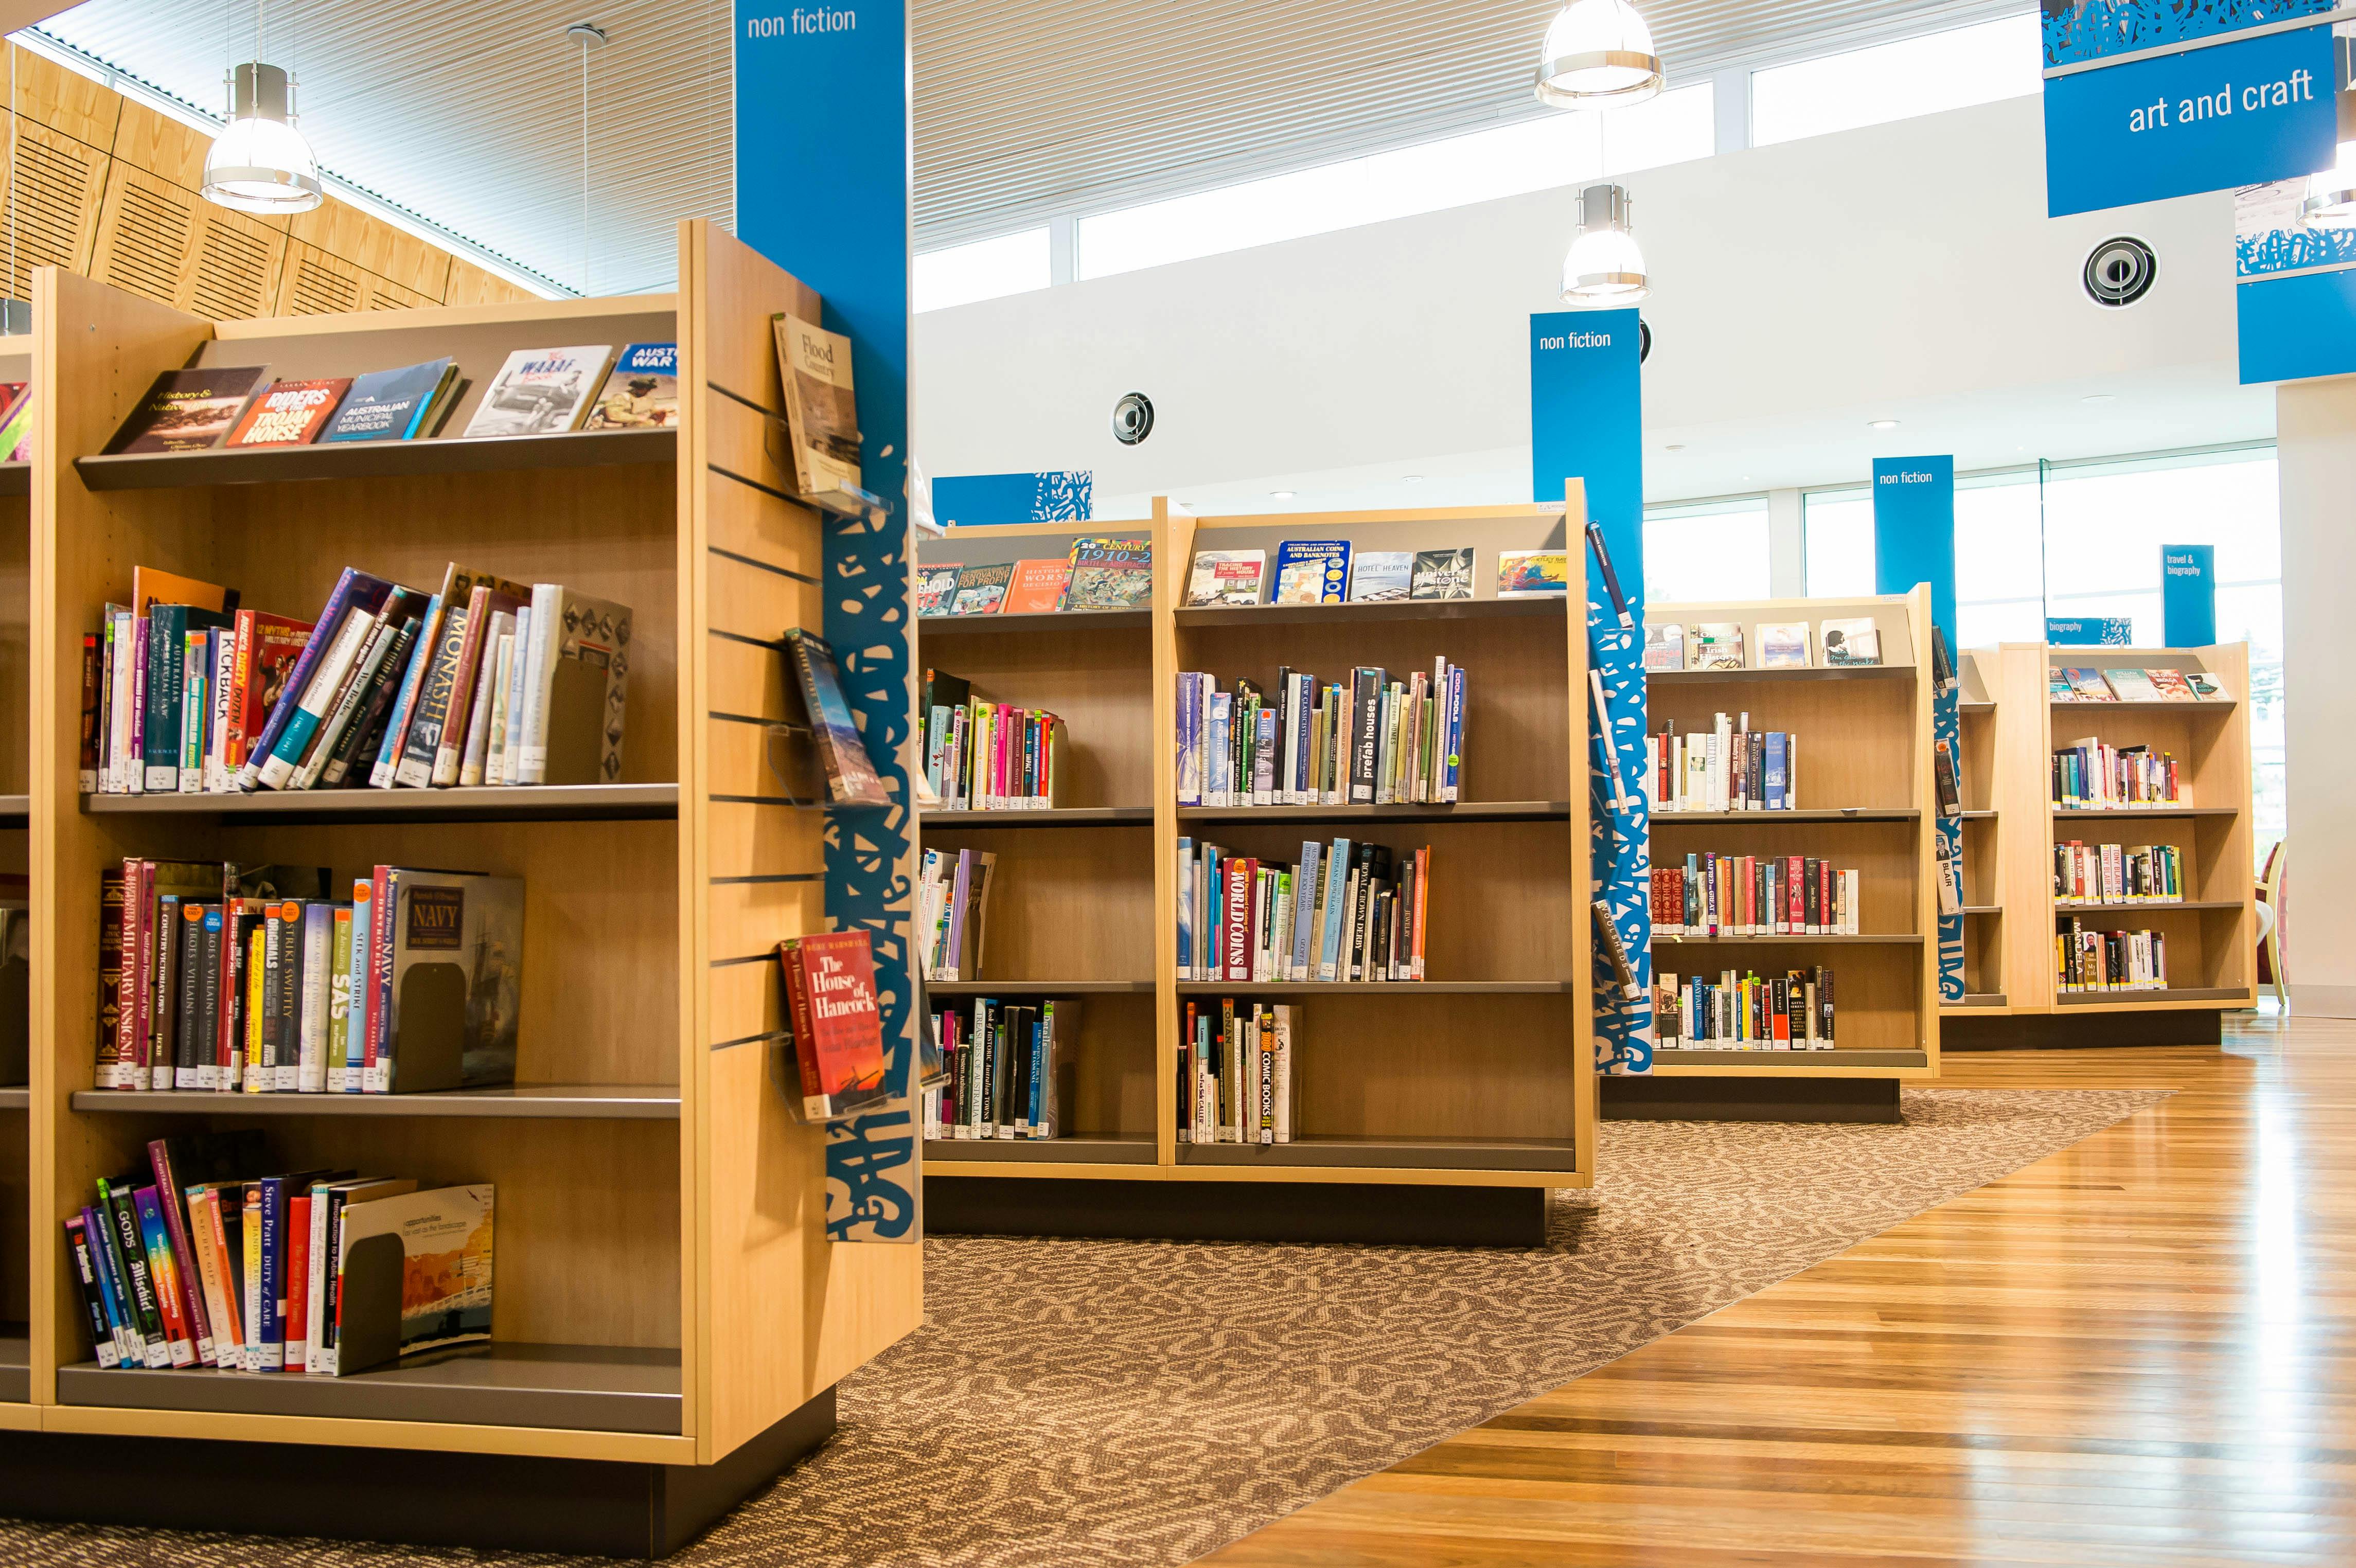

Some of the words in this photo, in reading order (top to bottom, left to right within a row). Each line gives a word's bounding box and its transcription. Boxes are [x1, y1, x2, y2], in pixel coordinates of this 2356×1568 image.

[748, 16, 785, 39] non
[791, 6, 856, 34] fiction
[2129, 97, 2169, 133] art
[2178, 83, 2231, 123] and
[2242, 68, 2313, 112] craft
[802, 334, 835, 364] Flood
[1540, 336, 1564, 350] non
[1568, 331, 1611, 348] fiction
[632, 356, 673, 368] WAR
[264, 388, 330, 408] RIDERS
[345, 400, 411, 417] AUSTRALIAN
[254, 409, 316, 427] TROJAN
[337, 420, 392, 432] YEARBOOK
[340, 412, 395, 424] MUNICIPAL
[241, 423, 307, 444] HORSE
[1880, 474, 1898, 485] non
[1900, 471, 1932, 483] fiction
[1103, 543, 1146, 551] CENTURY
[2167, 554, 2187, 564] travel
[2188, 555, 2193, 564] &
[958, 579, 977, 588] FOR
[977, 575, 1009, 586] PROFIT
[960, 569, 1011, 581] RENOVATING
[1358, 564, 1378, 573] HOTEL
[1431, 575, 1468, 585] stone
[2167, 565, 2201, 576] biography
[2049, 621, 2082, 632] biography
[330, 628, 350, 658] Australian
[172, 644, 181, 702] AUSTRALIAN
[218, 638, 235, 720] KICKBACK
[235, 651, 247, 688] DIRTY
[317, 657, 335, 682] Infantry
[425, 614, 469, 721] MONASH
[231, 687, 243, 724] DOZEN
[303, 681, 323, 708] Battalion
[1363, 699, 1376, 739] houses
[1259, 749, 1270, 775] Hand
[1361, 742, 1374, 777] prefab
[1309, 847, 1317, 882] AUSTRALIAN
[1360, 862, 1368, 888] ROYAL
[1942, 862, 1952, 886] BLAIR
[2103, 866, 2111, 884] BLAIR
[1230, 872, 1244, 922] WORLD
[1357, 889, 1366, 920] CROWN
[413, 904, 458, 928] NAVY
[264, 917, 280, 968] ORIGINALS
[285, 922, 295, 963] STRIKE
[355, 932, 363, 954] SEEK
[1230, 923, 1244, 965] COINS
[1355, 922, 1363, 950] DERBY
[2074, 922, 2083, 974] MANDELA
[121, 923, 136, 997] MILITARY
[337, 935, 347, 969] Amazing
[380, 942, 393, 986] NAVY
[820, 955, 844, 973] The
[185, 968, 196, 1014] VILLAINS
[205, 969, 215, 1014] VILLAINS
[283, 969, 294, 1018] SWIFTLY
[352, 978, 361, 1009] STRIKE
[812, 971, 856, 993] House
[853, 982, 865, 999] of
[329, 973, 351, 1020] SAS
[814, 991, 876, 1019] Hancock
[974, 1012, 983, 1057] TREASURES
[1042, 1015, 1050, 1046] Details
[1261, 1032, 1271, 1051] 1000
[975, 1059, 981, 1071] OF
[1262, 1053, 1270, 1082] COMIC
[972, 1073, 981, 1117] AUSTRALIA
[1262, 1084, 1270, 1115] BOOKS
[264, 1186, 274, 1215] Steve
[263, 1220, 273, 1246] Pratt
[331, 1199, 340, 1244] Introduction
[117, 1210, 136, 1249] GODS
[129, 1260, 155, 1313] Mischief
[262, 1287, 270, 1295] of
